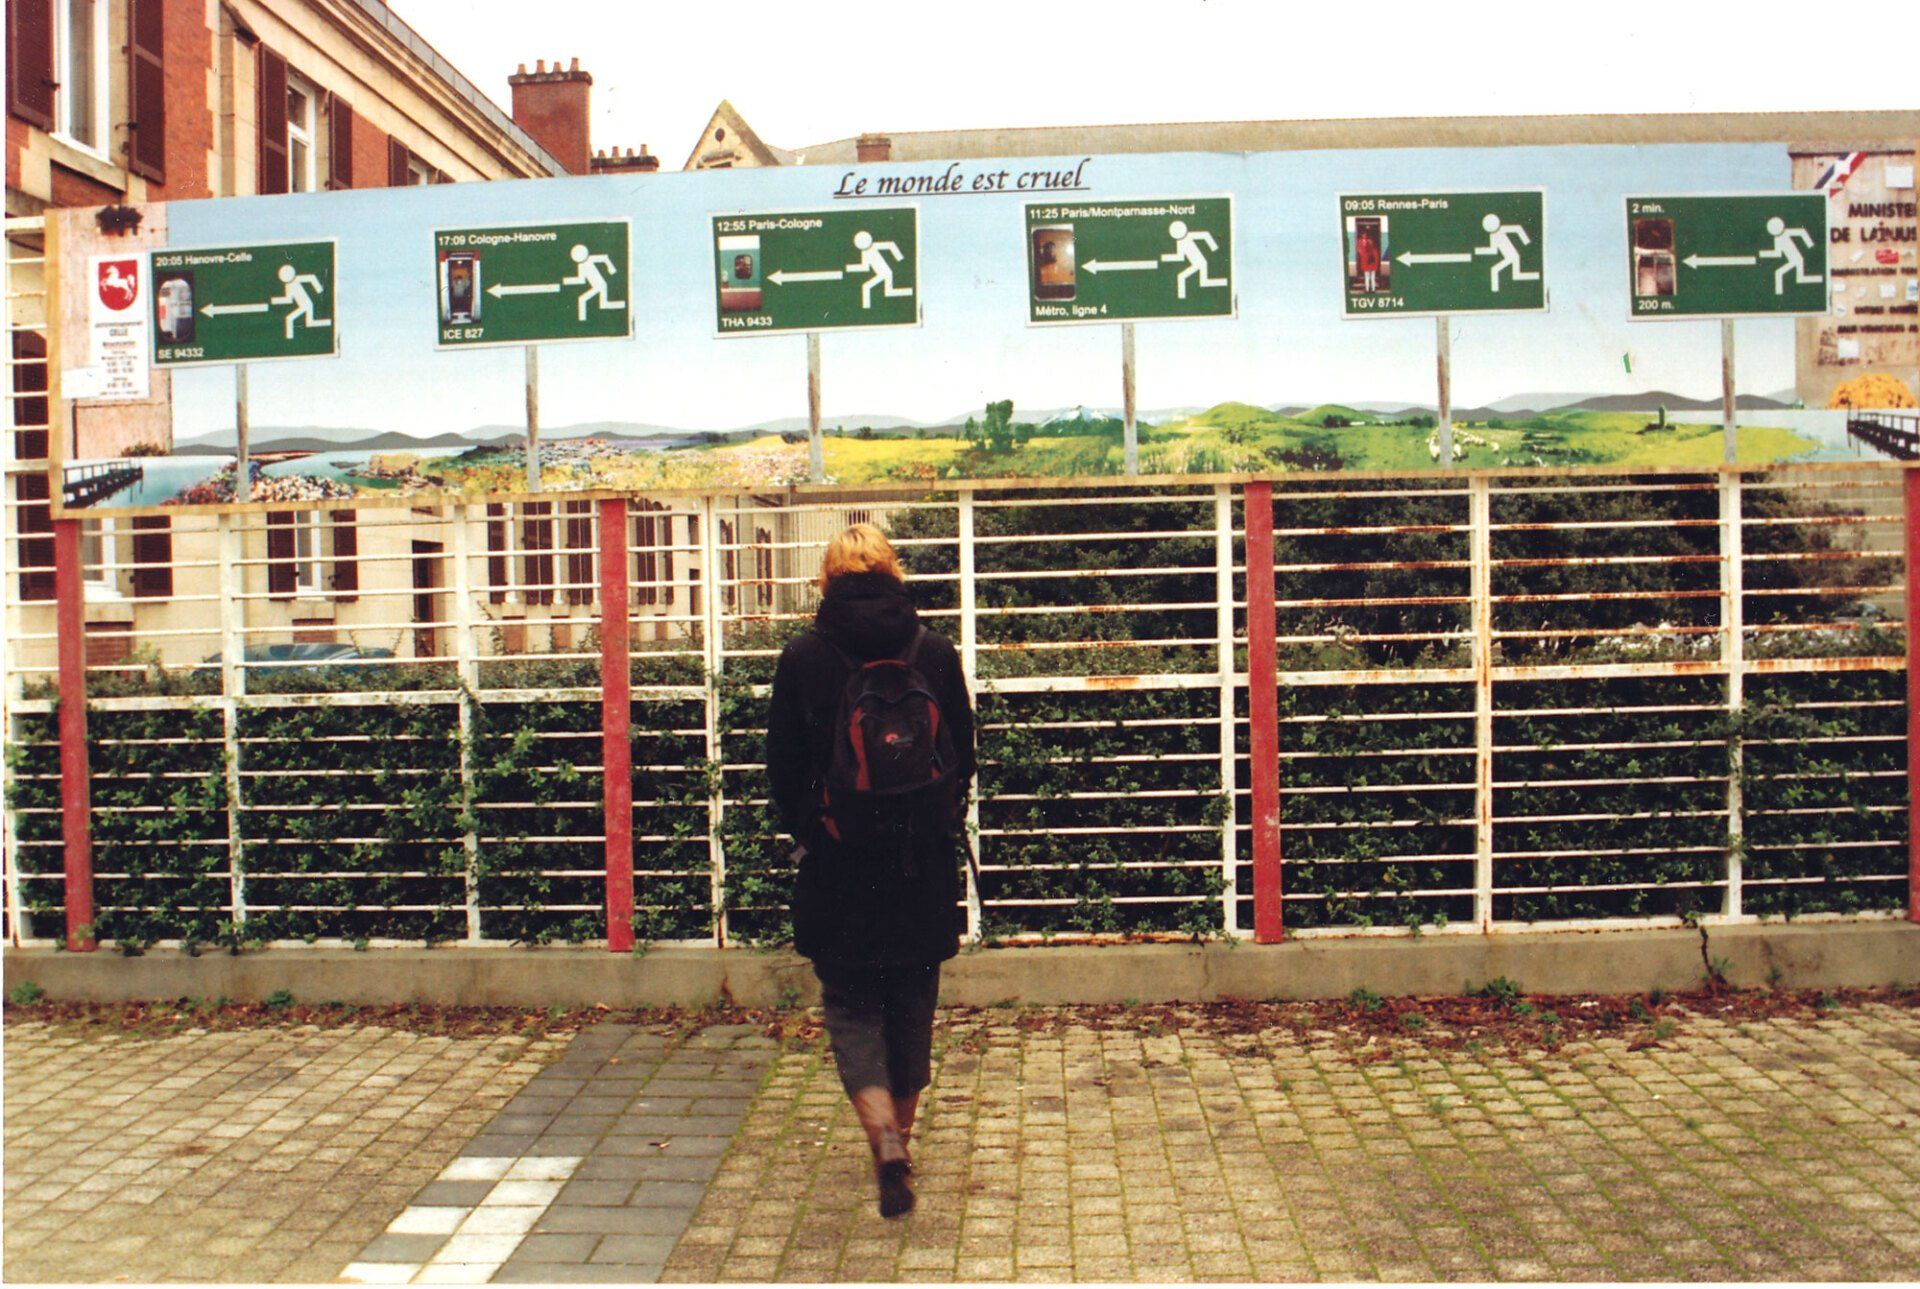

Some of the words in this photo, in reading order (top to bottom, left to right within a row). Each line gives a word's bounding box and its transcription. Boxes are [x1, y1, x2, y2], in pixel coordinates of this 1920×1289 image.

[834, 172, 867, 195] Le
[877, 162, 963, 193] monde
[972, 173, 1009, 190] est
[1017, 158, 1091, 188] cruel
[1345, 200, 1374, 210] 09:05
[1378, 198, 1448, 210] Rennes-Paris
[1633, 203, 1639, 213] 2
[1642, 203, 1665, 213] min.
[1030, 208, 1058, 218] 11:25
[1062, 205, 1195, 218] Paris/Montparnasse-Nord
[717, 221, 745, 231] 12:55
[749, 218, 822, 231] Paris-Cologne
[438, 235, 465, 245] 17:09
[469, 232, 557, 245] Cologne-Hanovre
[1830, 226, 1850, 242] DE
[156, 256, 182, 267] 20:05
[185, 252, 252, 264] Hanovre-Celle
[1352, 298, 1374, 308] TGV
[1378, 297, 1404, 307] 8714
[1639, 299, 1658, 309] 200
[1662, 301, 1674, 309] m.
[1036, 304, 1069, 316] Métro,
[1073, 304, 1097, 317] ligne
[1101, 304, 1107, 313] 4
[722, 317, 744, 327] THA
[748, 316, 772, 326] 9433
[444, 329, 461, 339] ICE
[465, 328, 484, 338] 827
[158, 349, 171, 359] SE
